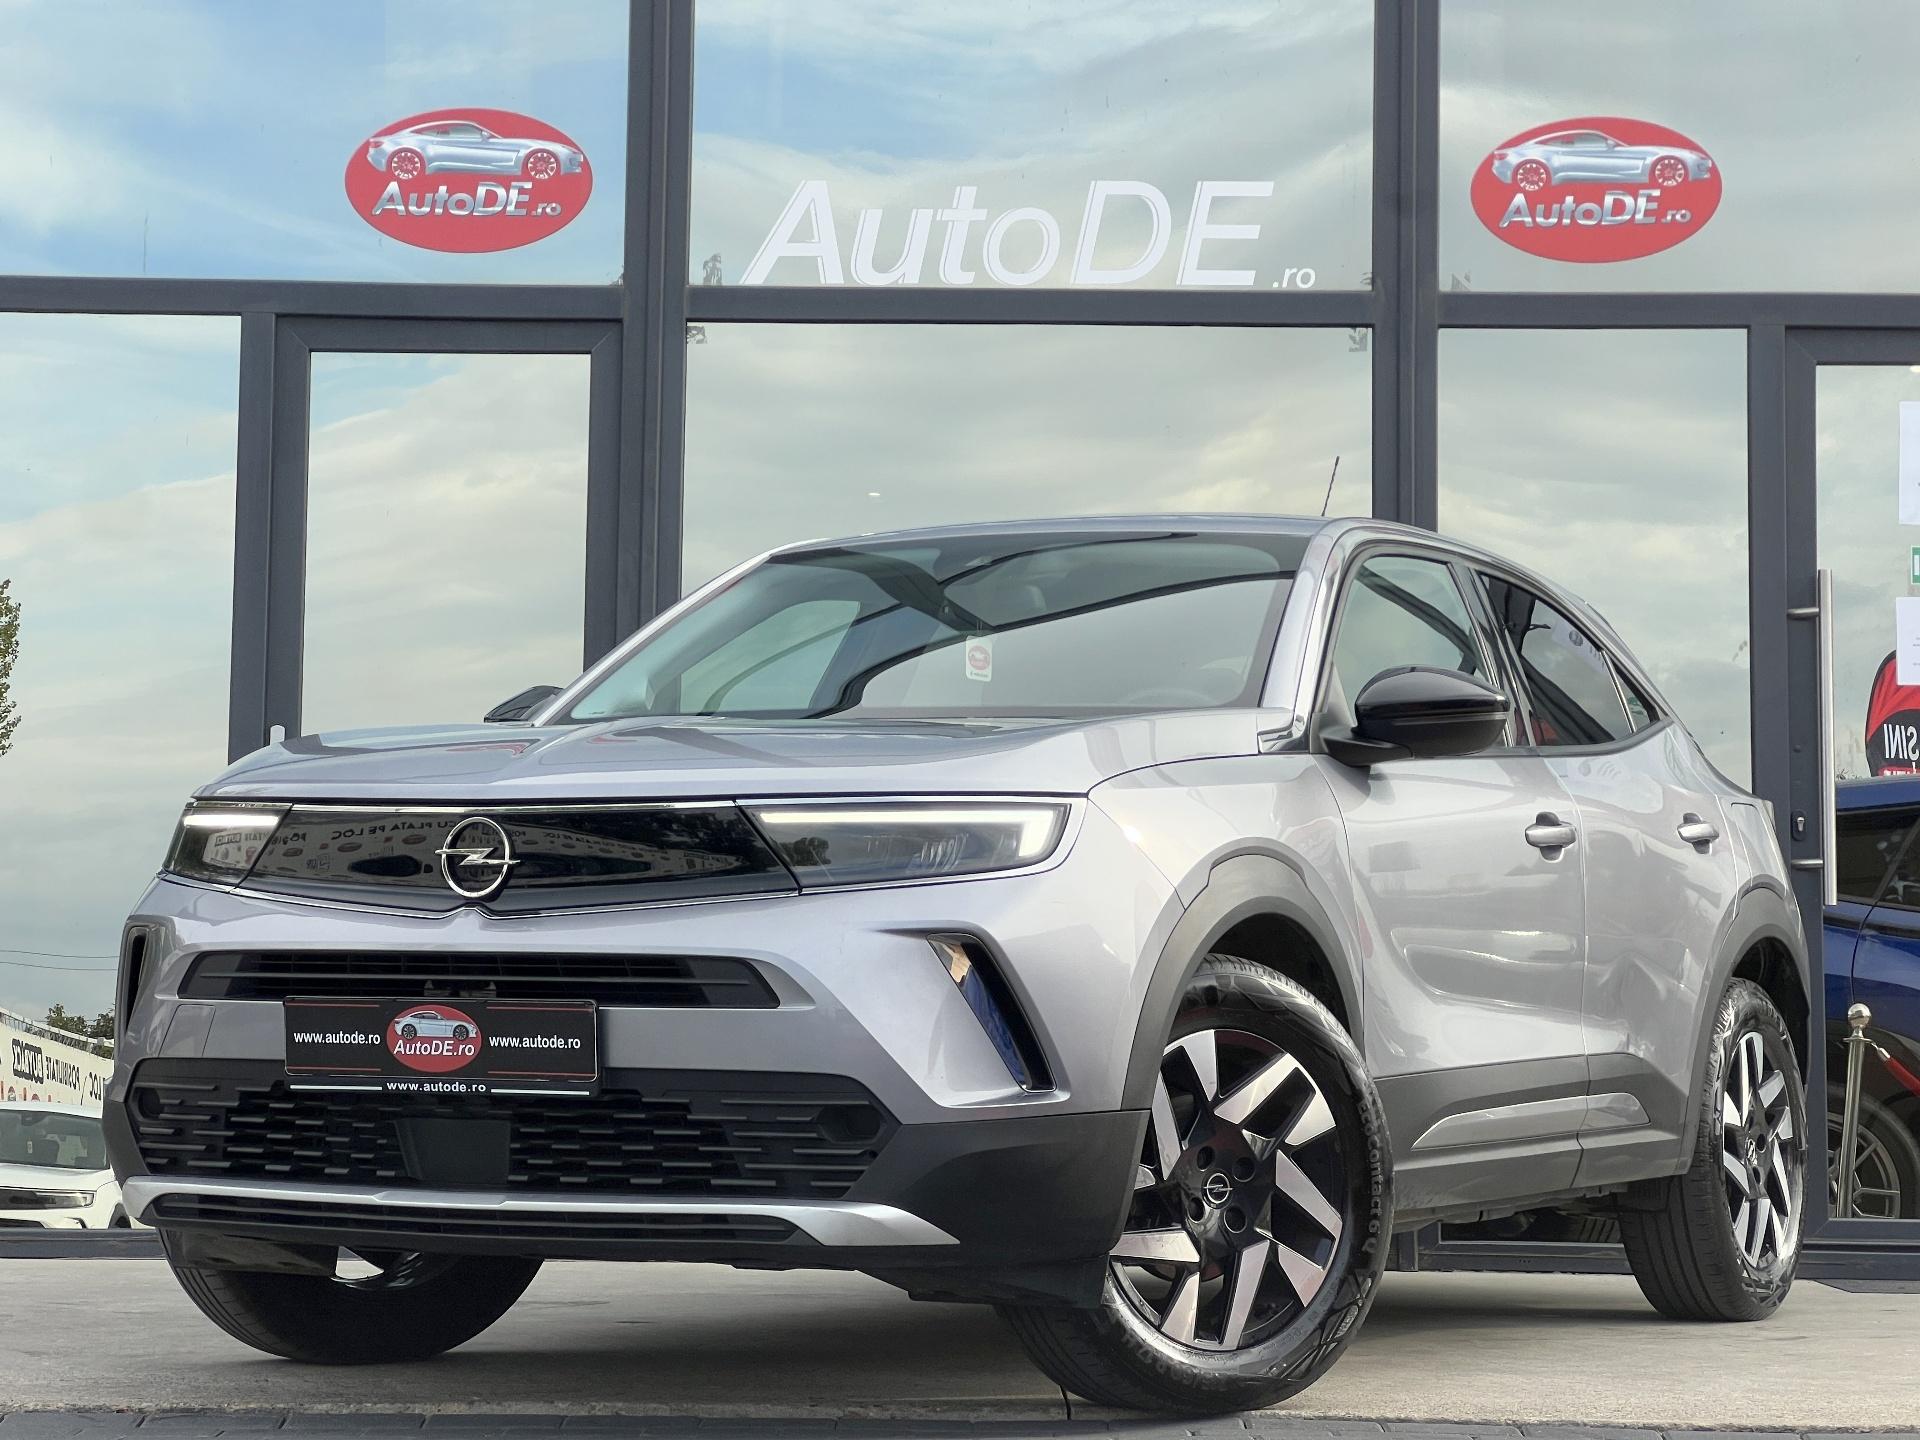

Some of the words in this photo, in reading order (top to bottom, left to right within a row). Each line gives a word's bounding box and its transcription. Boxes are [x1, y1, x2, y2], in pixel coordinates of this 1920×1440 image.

[293, 1030, 381, 1045] www.autode.ro
[488, 1034, 581, 1050] www.autode.ro
[393, 1039, 476, 1057] AutoDE.ro
[386, 1081, 487, 1093] www.autode.ro
